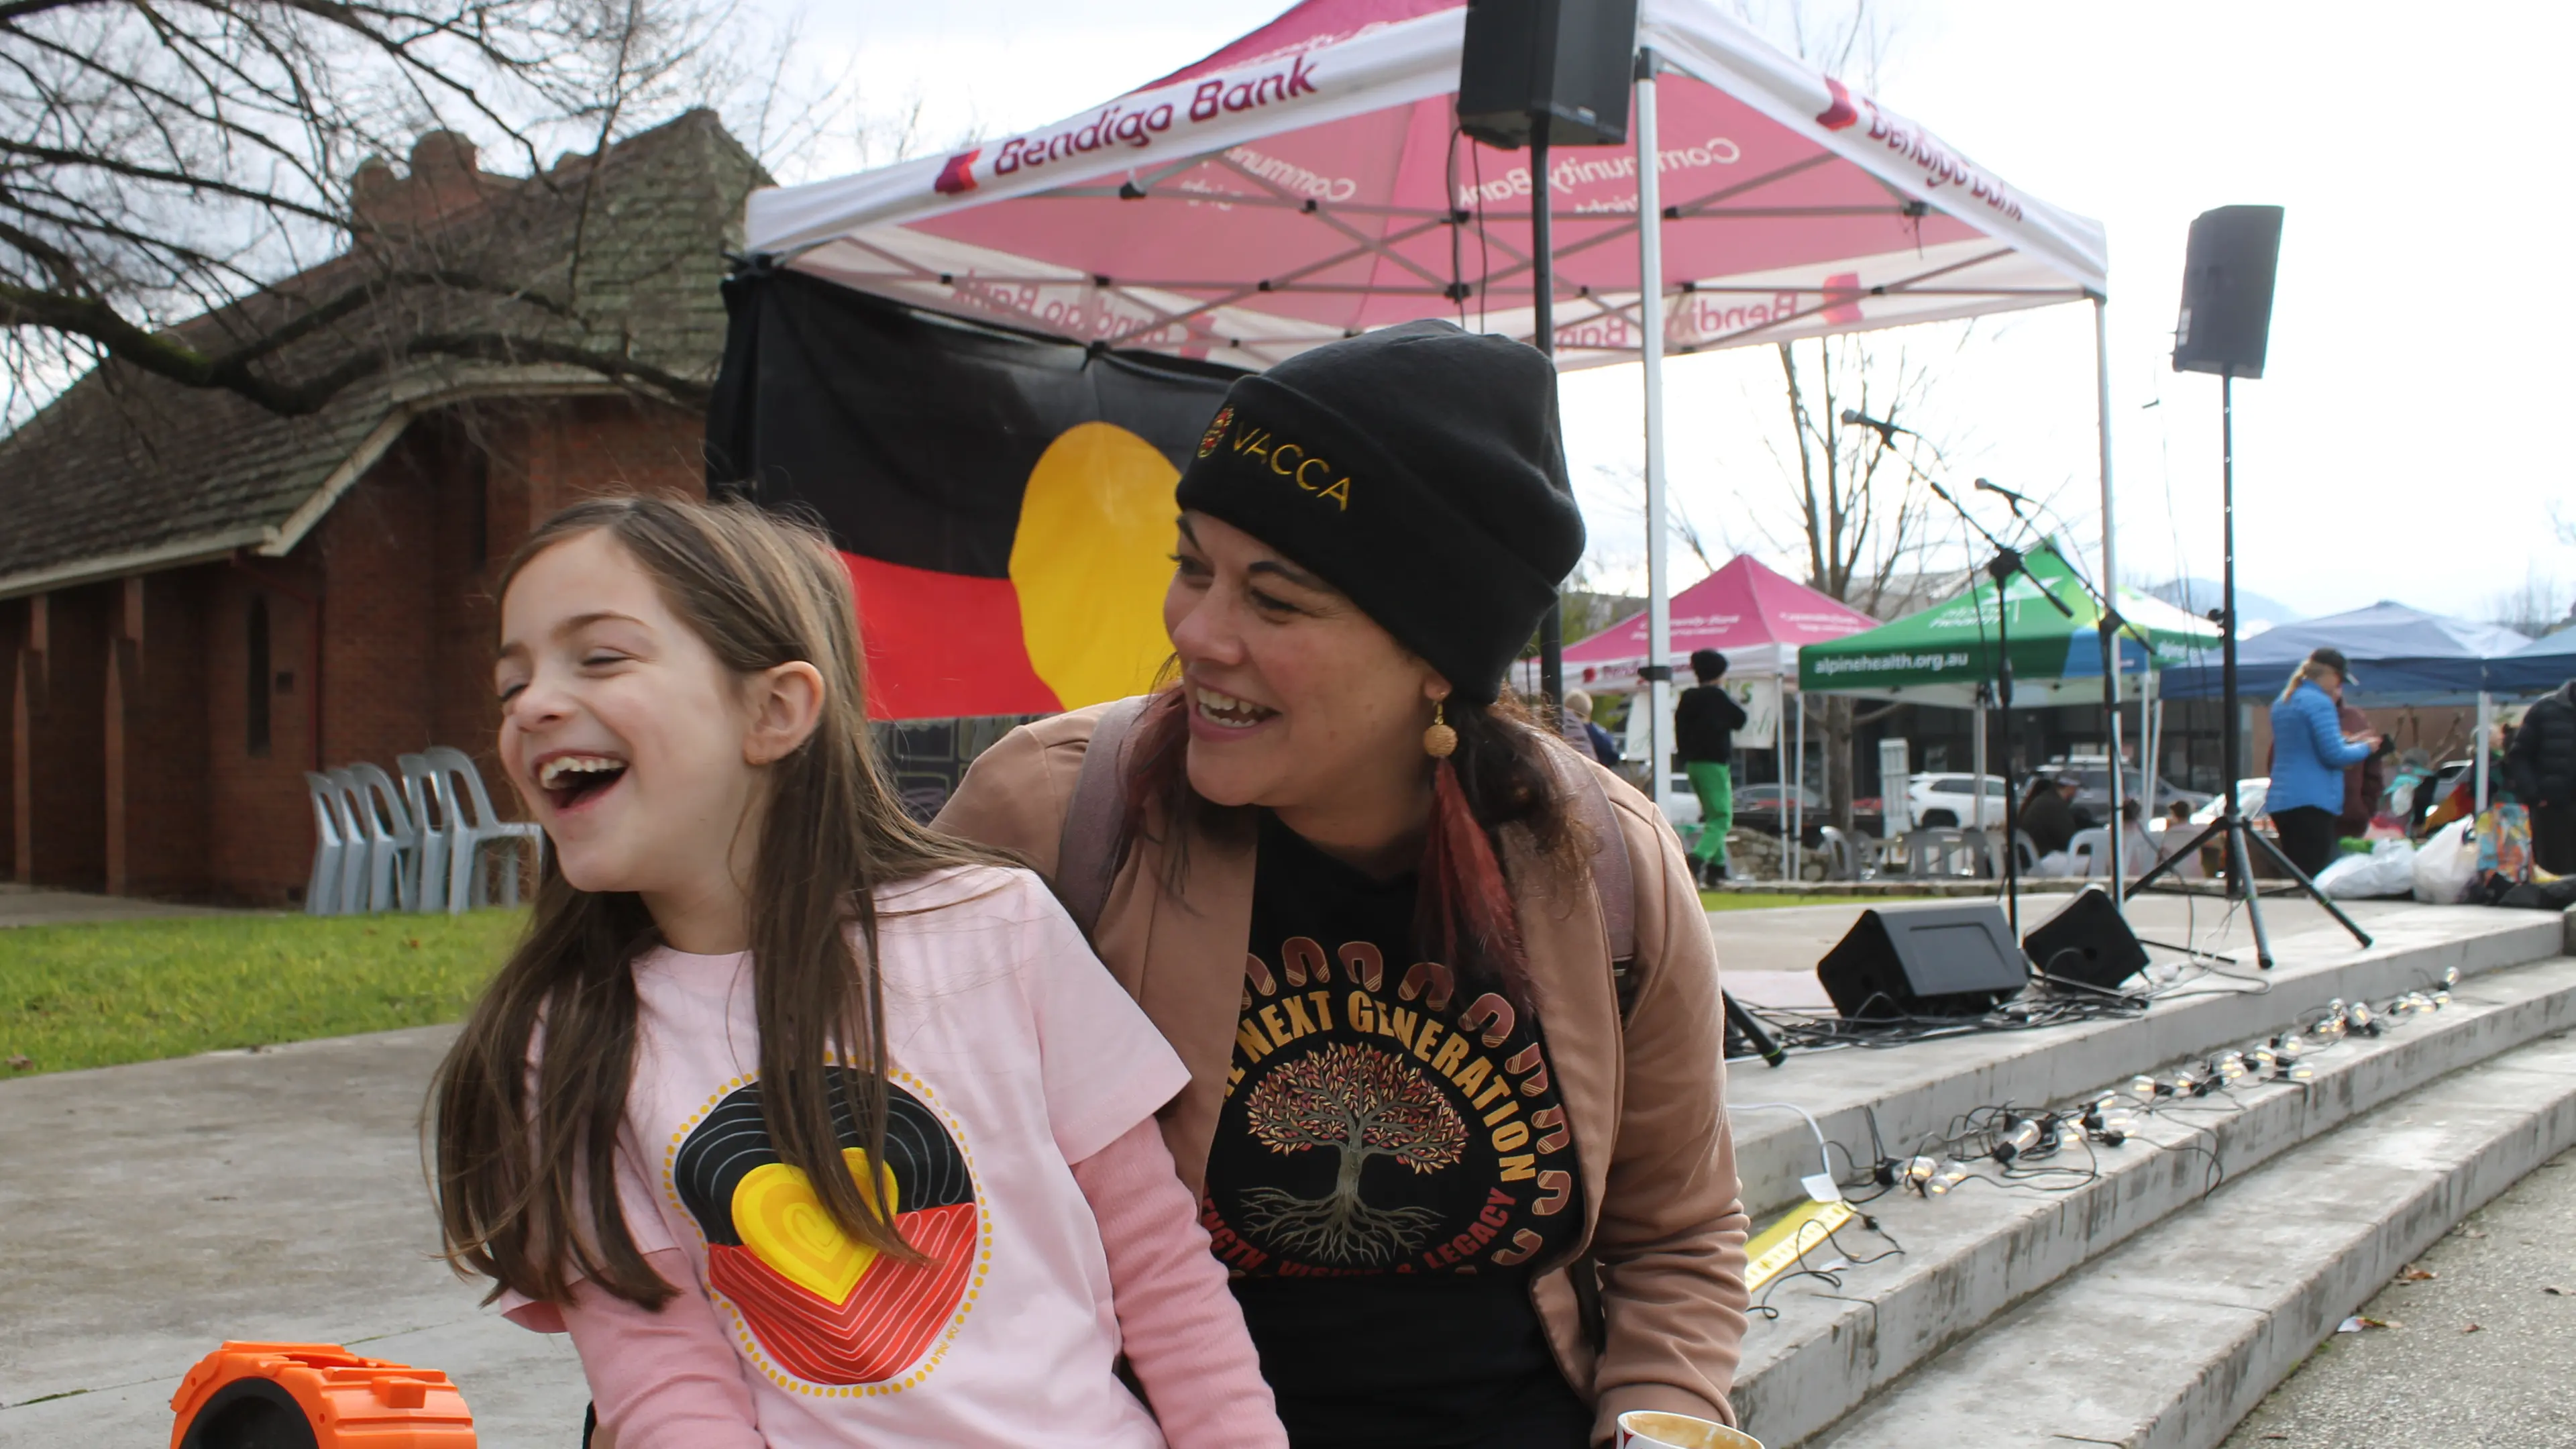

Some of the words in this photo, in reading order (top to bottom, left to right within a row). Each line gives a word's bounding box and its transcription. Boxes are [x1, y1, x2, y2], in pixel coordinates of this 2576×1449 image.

[994, 103, 1174, 176] Bendigo
[1189, 54, 1318, 123] Bank
[1234, 421, 1350, 511] VACCA
[1814, 652, 1969, 676] alpinehealth.org.au
[1236, 991, 1332, 1065] NEXT
[1348, 991, 1536, 1182] GENERATION
[1422, 1187, 1517, 1270] LEGACY
